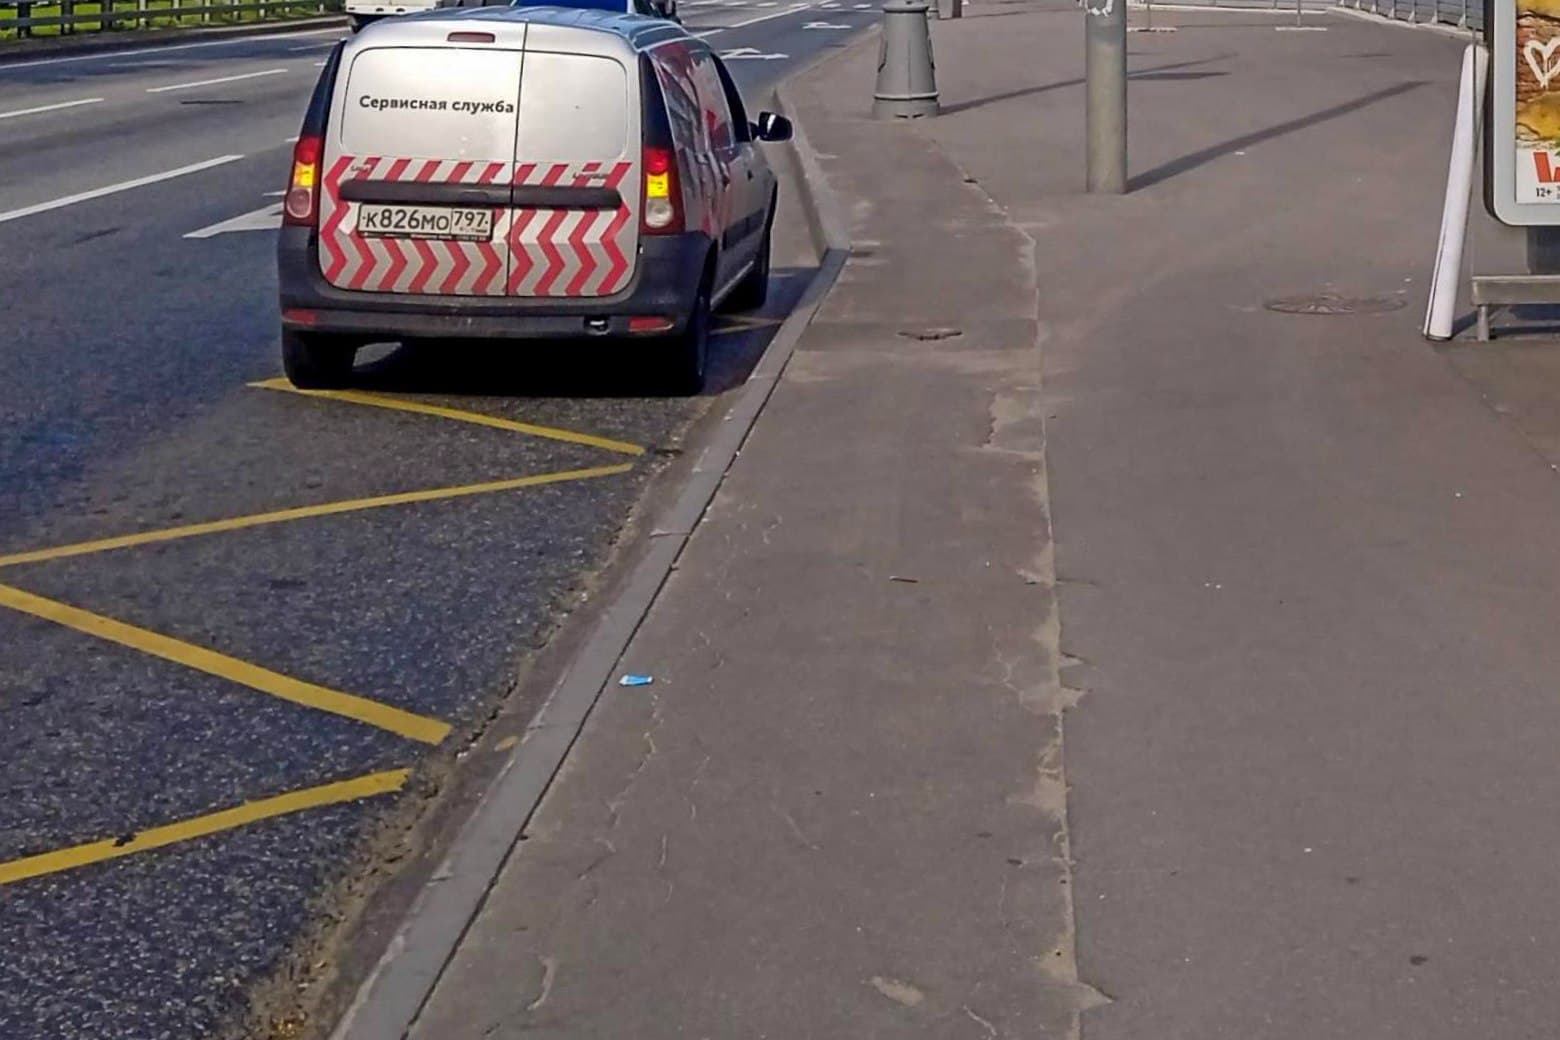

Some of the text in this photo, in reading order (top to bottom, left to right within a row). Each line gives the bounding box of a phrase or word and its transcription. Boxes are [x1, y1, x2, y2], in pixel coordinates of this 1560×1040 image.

[359, 95, 515, 115] Сервисная служба
[1536, 187, 1552, 198] 12+
[365, 208, 487, 231] К826МО 797
